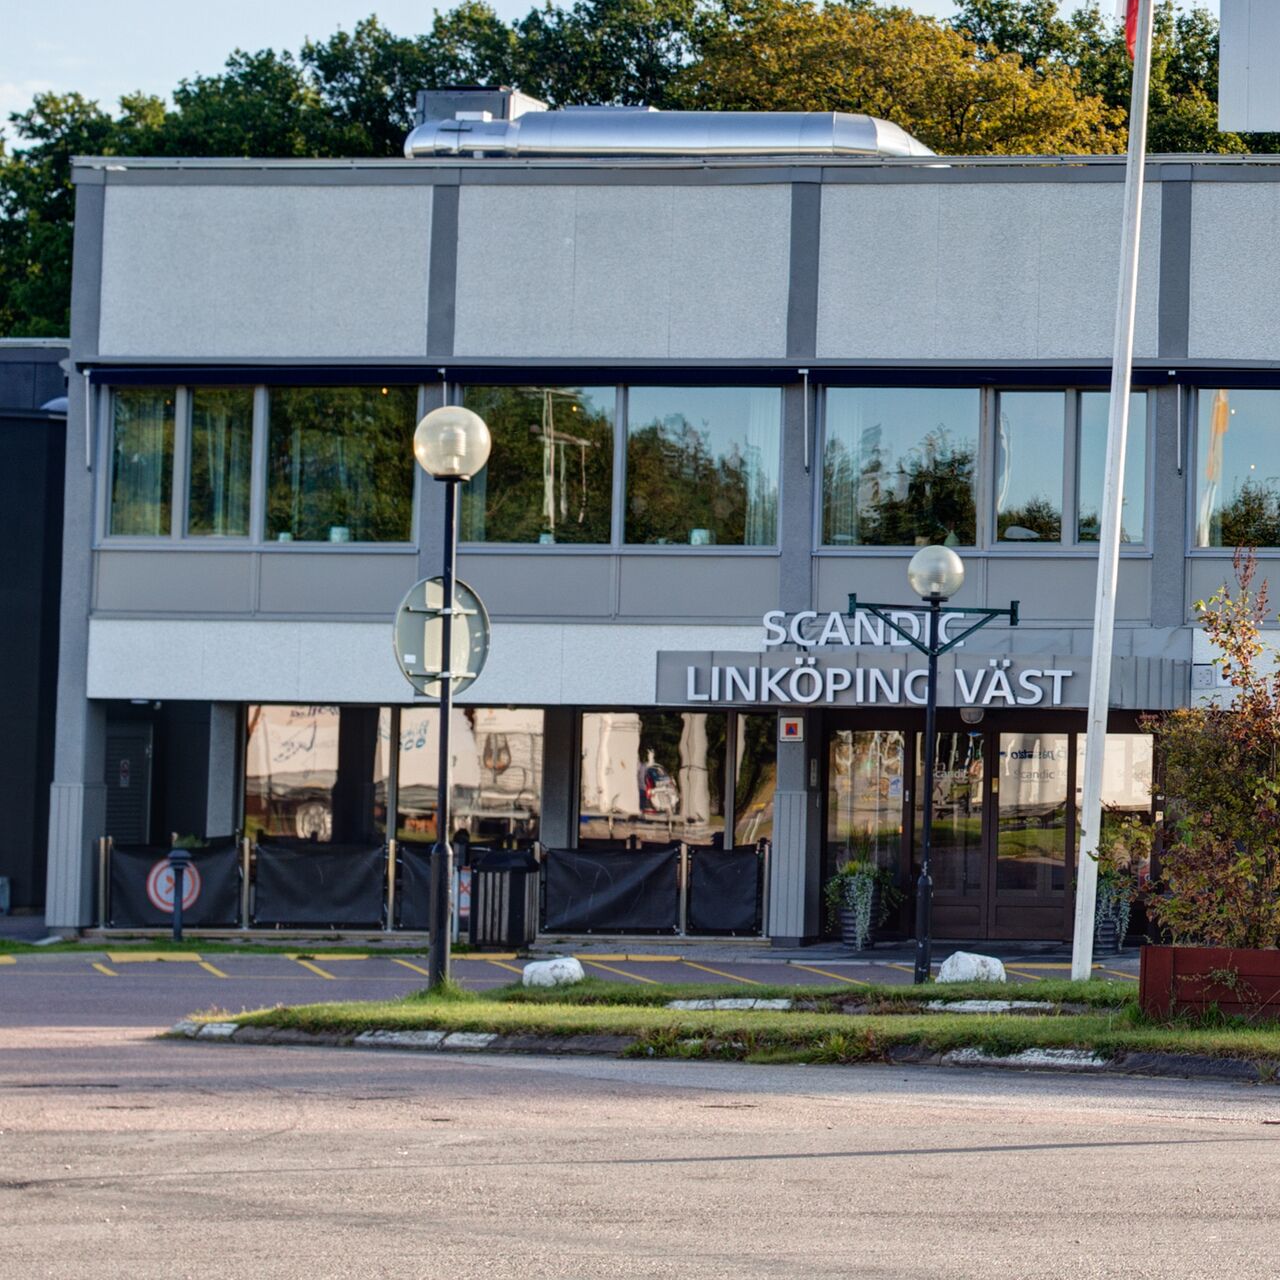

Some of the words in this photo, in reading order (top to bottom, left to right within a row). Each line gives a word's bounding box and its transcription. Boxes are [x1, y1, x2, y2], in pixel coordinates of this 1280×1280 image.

[762, 610, 964, 647] SCANDIC
[687, 657, 929, 704] LINKÖPING
[955, 658, 1073, 705] VÄST
